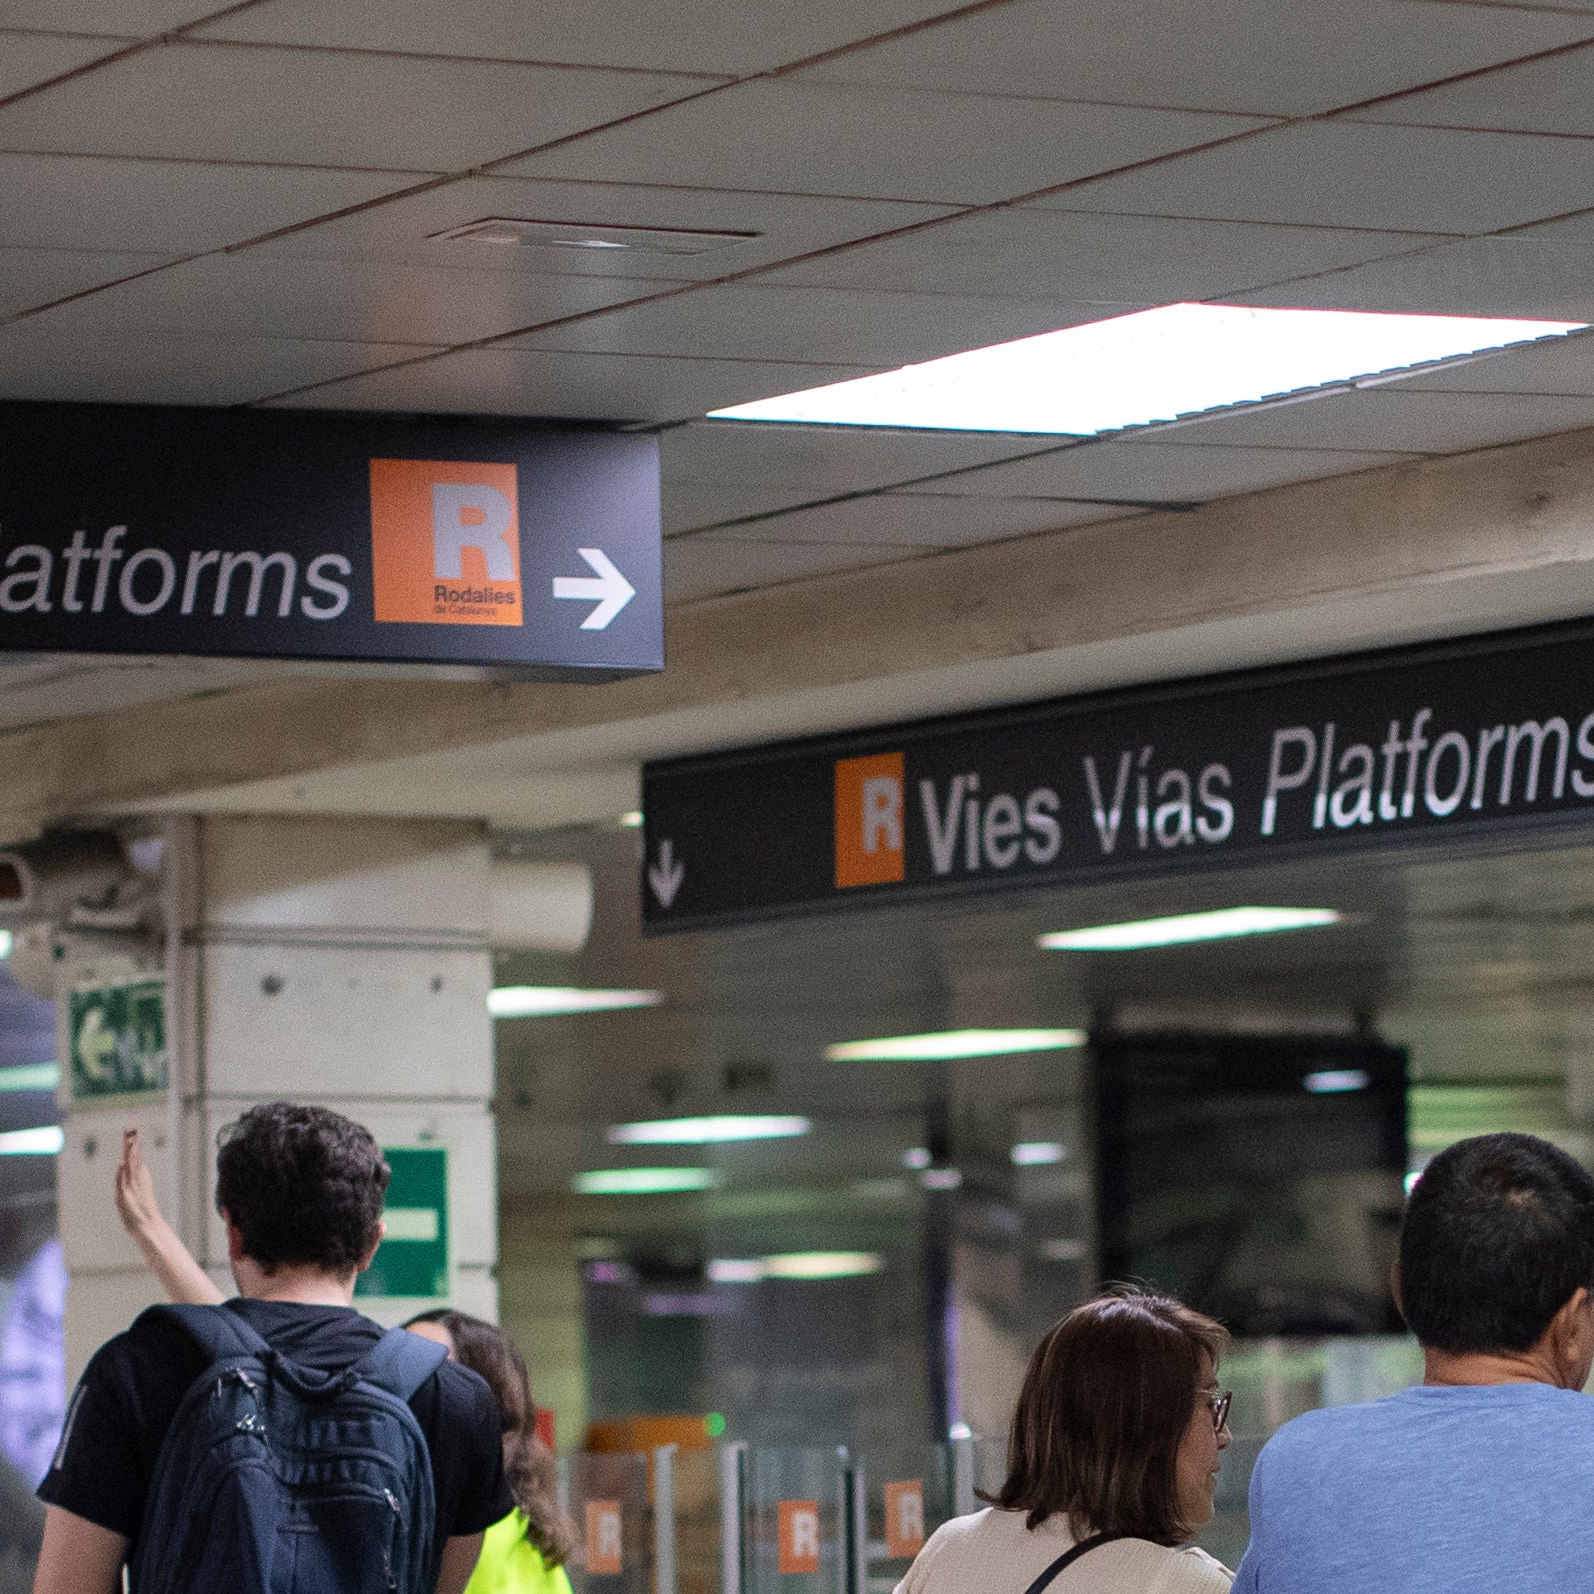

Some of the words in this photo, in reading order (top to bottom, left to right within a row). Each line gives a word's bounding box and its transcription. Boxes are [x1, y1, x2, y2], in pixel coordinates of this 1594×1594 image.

[432, 483, 516, 581] R
[433, 584, 516, 605] Rodalies
[862, 776, 904, 854] R
[919, 773, 1063, 876] Vies
[1082, 745, 1233, 855] Vías
[792, 1511, 819, 1557] R
